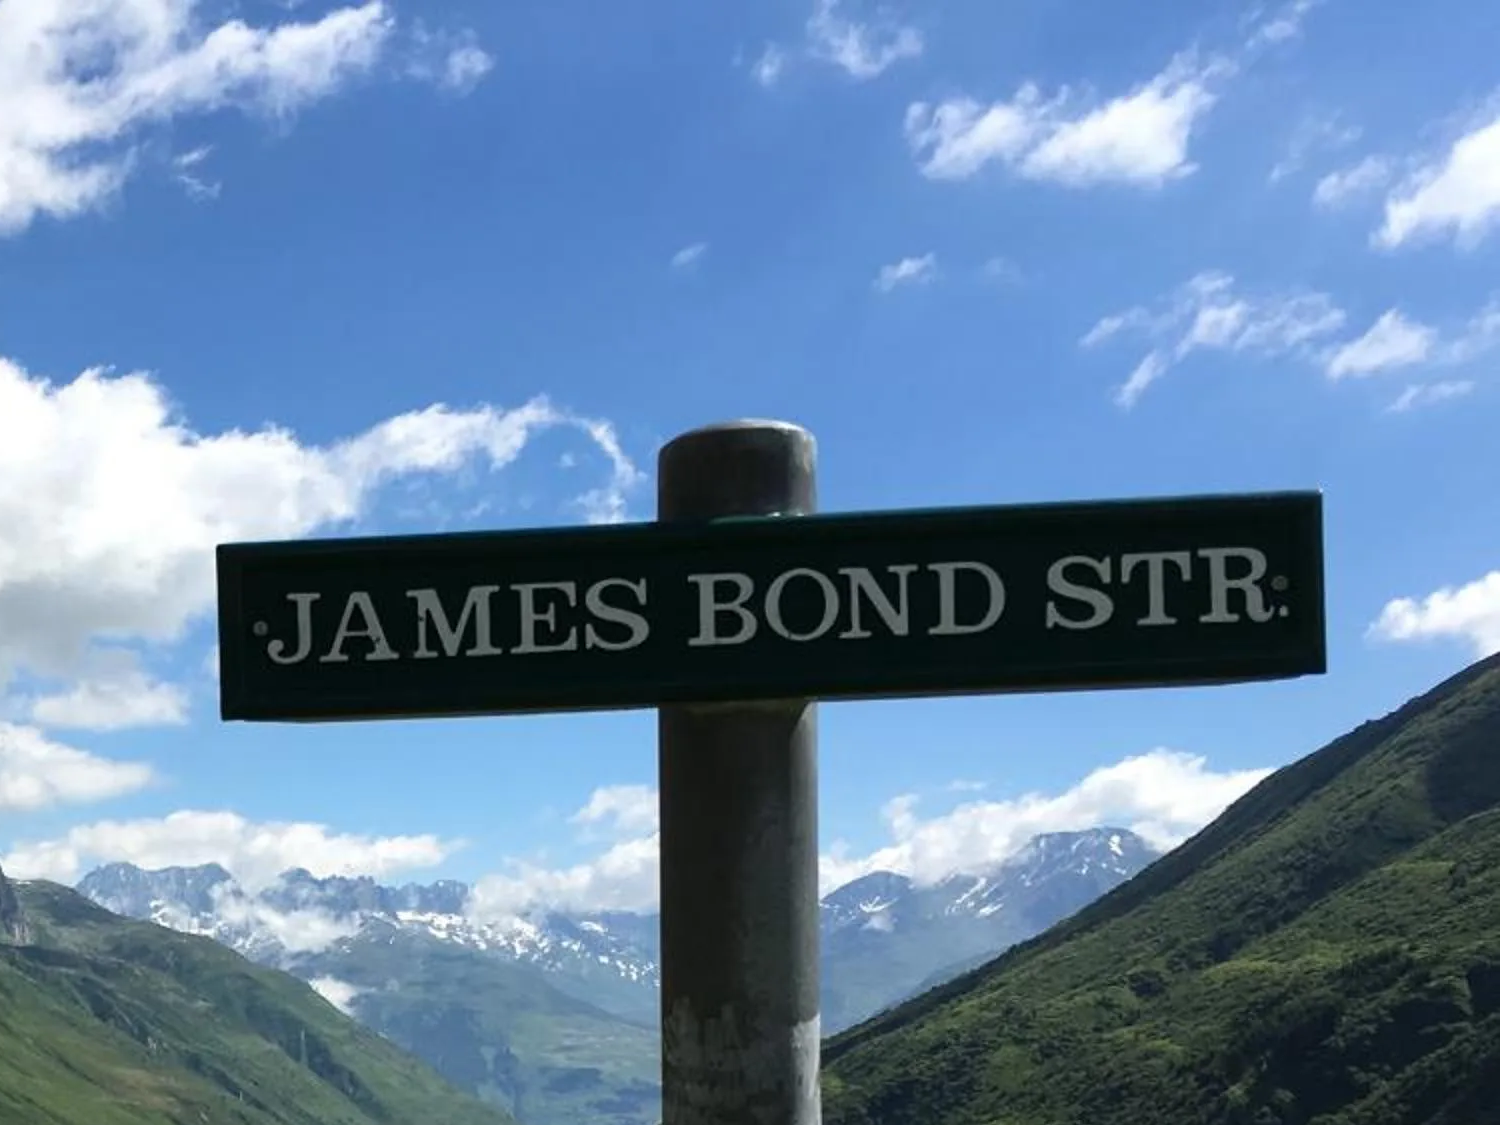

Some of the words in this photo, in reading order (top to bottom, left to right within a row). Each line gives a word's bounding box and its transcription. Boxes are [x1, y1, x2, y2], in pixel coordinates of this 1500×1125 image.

[267, 578, 649, 664] JAMES
[687, 561, 1005, 646] BOND
[1046, 547, 1289, 629] STR.
